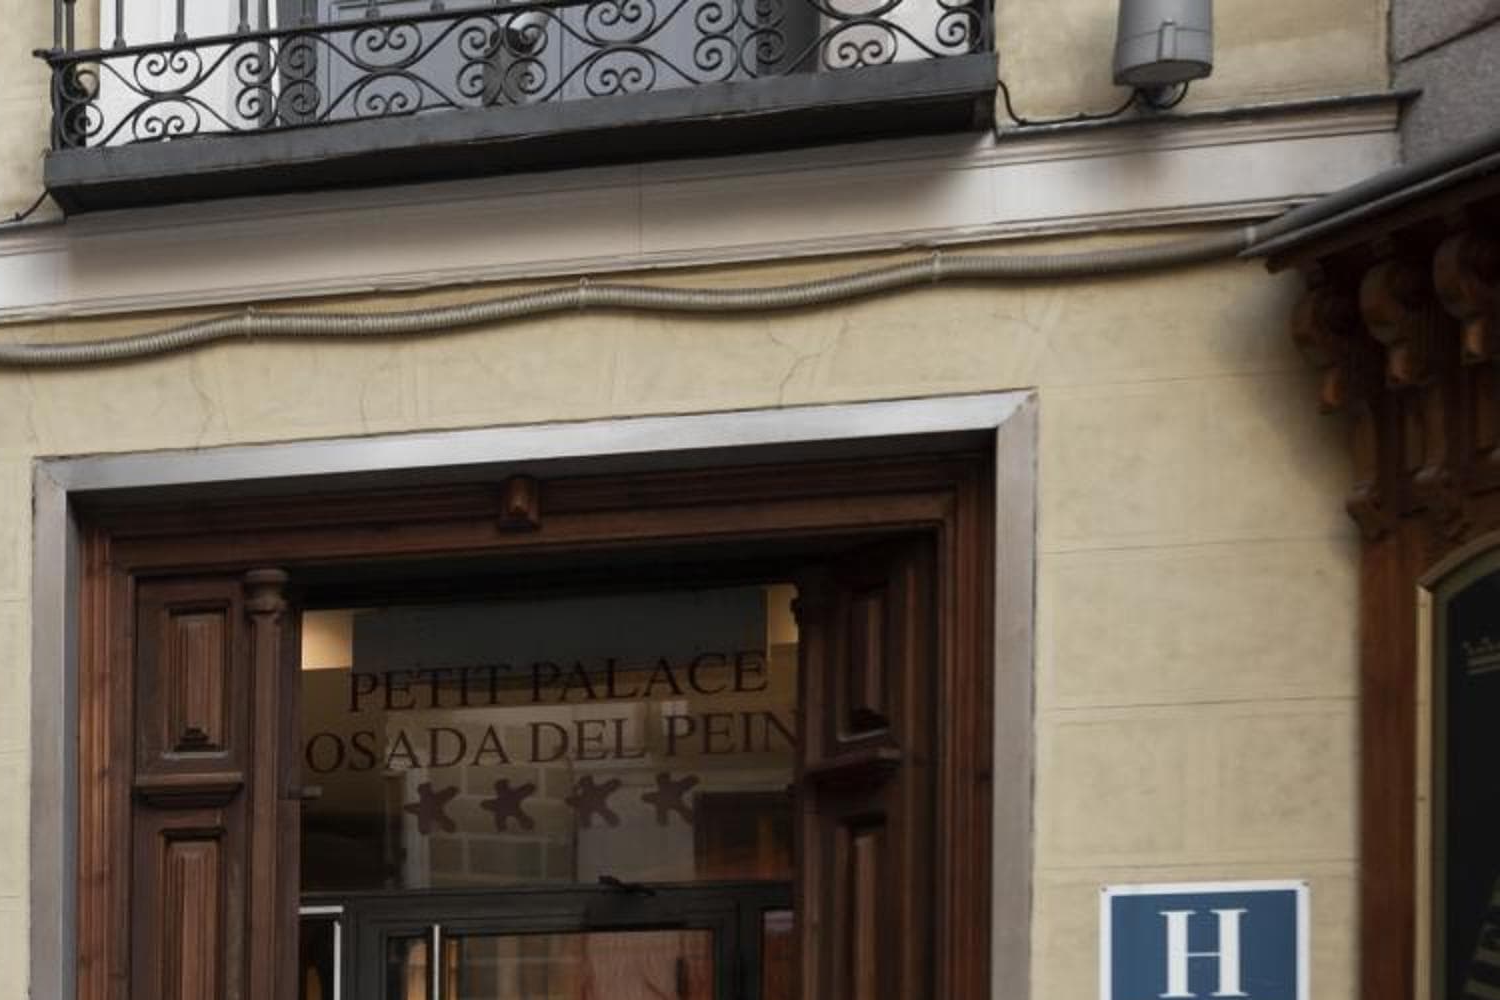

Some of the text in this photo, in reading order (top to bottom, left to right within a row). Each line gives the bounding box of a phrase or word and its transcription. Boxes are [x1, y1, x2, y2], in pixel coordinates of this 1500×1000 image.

[349, 650, 768, 712] PETIT PALACE
[306, 708, 799, 773] OSADA DEL PEIN
[1158, 908, 1249, 998] H
